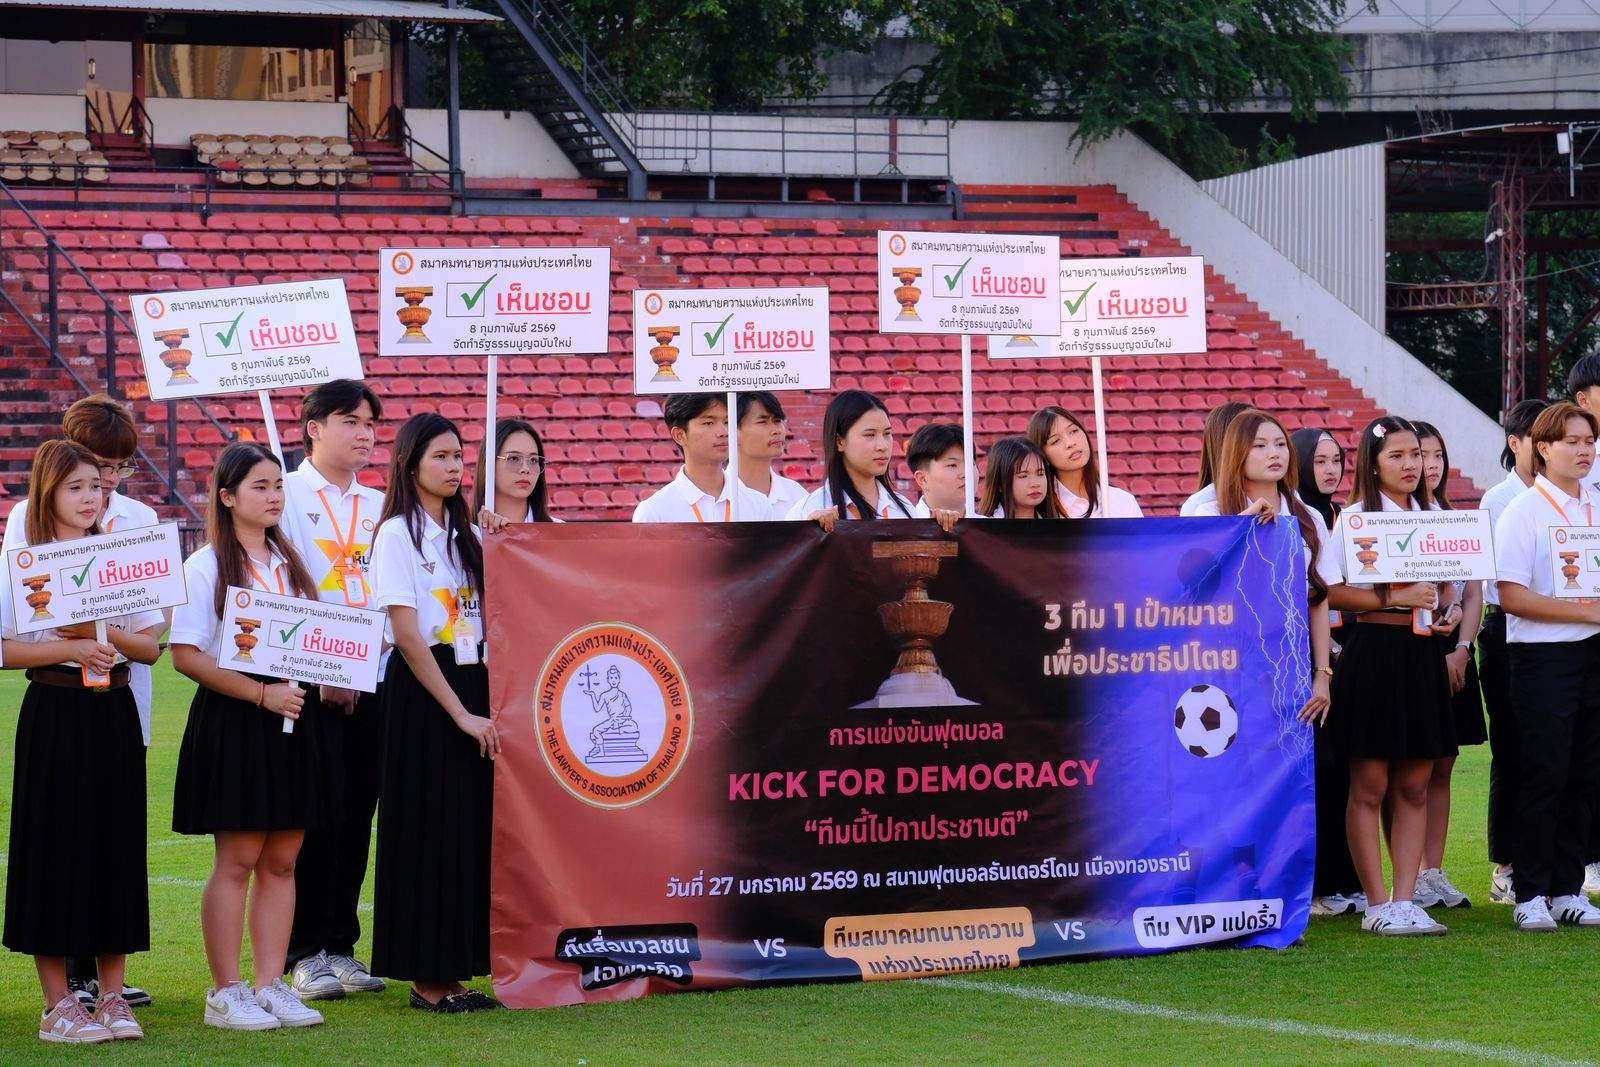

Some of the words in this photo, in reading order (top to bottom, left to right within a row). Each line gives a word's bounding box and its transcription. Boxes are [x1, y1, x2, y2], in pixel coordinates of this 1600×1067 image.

[911, 241, 1046, 254] สมาคมทนายความแห่งประเทศไทย
[420, 254, 592, 269] สมาคมทนายความแห่งประเทศไทย
[972, 266, 1046, 294] เห็นชอบ
[170, 286, 330, 312] สมาคมทนายความแห่งประเทศไทย
[497, 283, 590, 311] เห็นชอบ
[668, 294, 814, 309] สมาคมทนายความแห่งประเทศไทย
[952, 305, 957, 313] 8
[960, 304, 997, 317] กุมภาพันธ์
[999, 306, 1020, 314] 2569
[1098, 290, 1187, 316] เห็นชอบ
[250, 318, 338, 347] เห็นชอบ
[470, 324, 476, 333] 8
[480, 322, 527, 336] กุมภาพันธ์
[531, 324, 556, 333] 2569
[734, 322, 814, 349] เห็นชอบ
[1074, 328, 1080, 337] 8
[1084, 326, 1128, 339] กุมภาพันธ์
[1132, 326, 1156, 336] 2569
[231, 362, 238, 371] 8
[241, 355, 285, 373] กุมภาพันธ์
[288, 356, 311, 366] 2569
[712, 362, 718, 371] 8
[721, 360, 761, 374] กุมภาพันธ์
[764, 361, 786, 370] 2569
[38, 530, 166, 562] สมาคมทนายความแห่งประเทศไทย
[1419, 534, 1481, 553] เห็นชอบ
[98, 558, 169, 585] เห็นชอบ
[81, 598, 87, 606] 8
[89, 590, 125, 607] กุมภาพันธ์
[127, 587, 146, 598] 2569
[254, 599, 373, 626] สมาคมทนายความแห่งประเทศไทย
[1044, 604, 1062, 630] 3
[1071, 600, 1105, 629] ทีม
[1114, 602, 1125, 628] 1
[1135, 597, 1234, 628] เป้าหมาย
[303, 628, 369, 658] เห็นชอบ
[282, 654, 287, 662] 8
[324, 661, 342, 671] 2569
[1043, 638, 1238, 676] เพื่อประชาธิปไตย
[540, 634, 683, 712] สมาคมทนายความแห่งประเทศไทย
[829, 718, 1004, 749] การแข่งขันฟุตบอล
[546, 728, 559, 748] THE
[553, 748, 588, 789] LAWYER'S
[589, 779, 646, 797] ASSOCIATION
[647, 771, 658, 784] OF
[656, 726, 681, 772] THAILAND
[729, 771, 808, 800] KICK
[819, 768, 885, 797] FOR
[896, 759, 1099, 794] DEMOCRACY
[666, 870, 704, 898] วันที่
[709, 876, 734, 895] 27
[739, 876, 805, 895] มกราคม
[811, 871, 858, 891] 2569
[863, 873, 880, 888] ณ
[886, 857, 1079, 890] สนามฟุตบอลธันเดอร์โดม
[1085, 852, 1190, 877] เมืองทองธานี
[1054, 921, 1086, 941] VS
[1143, 916, 1169, 936] ทีม
[1176, 914, 1216, 934] VIP
[1222, 904, 1277, 932] แปดริ้ว
[564, 929, 690, 957] ทีมสื่อมวลชน
[754, 938, 787, 958] VS
[834, 921, 1024, 948] ทีมสมาคมทนายความ
[868, 950, 1010, 975] แห่งประเทศไทย
